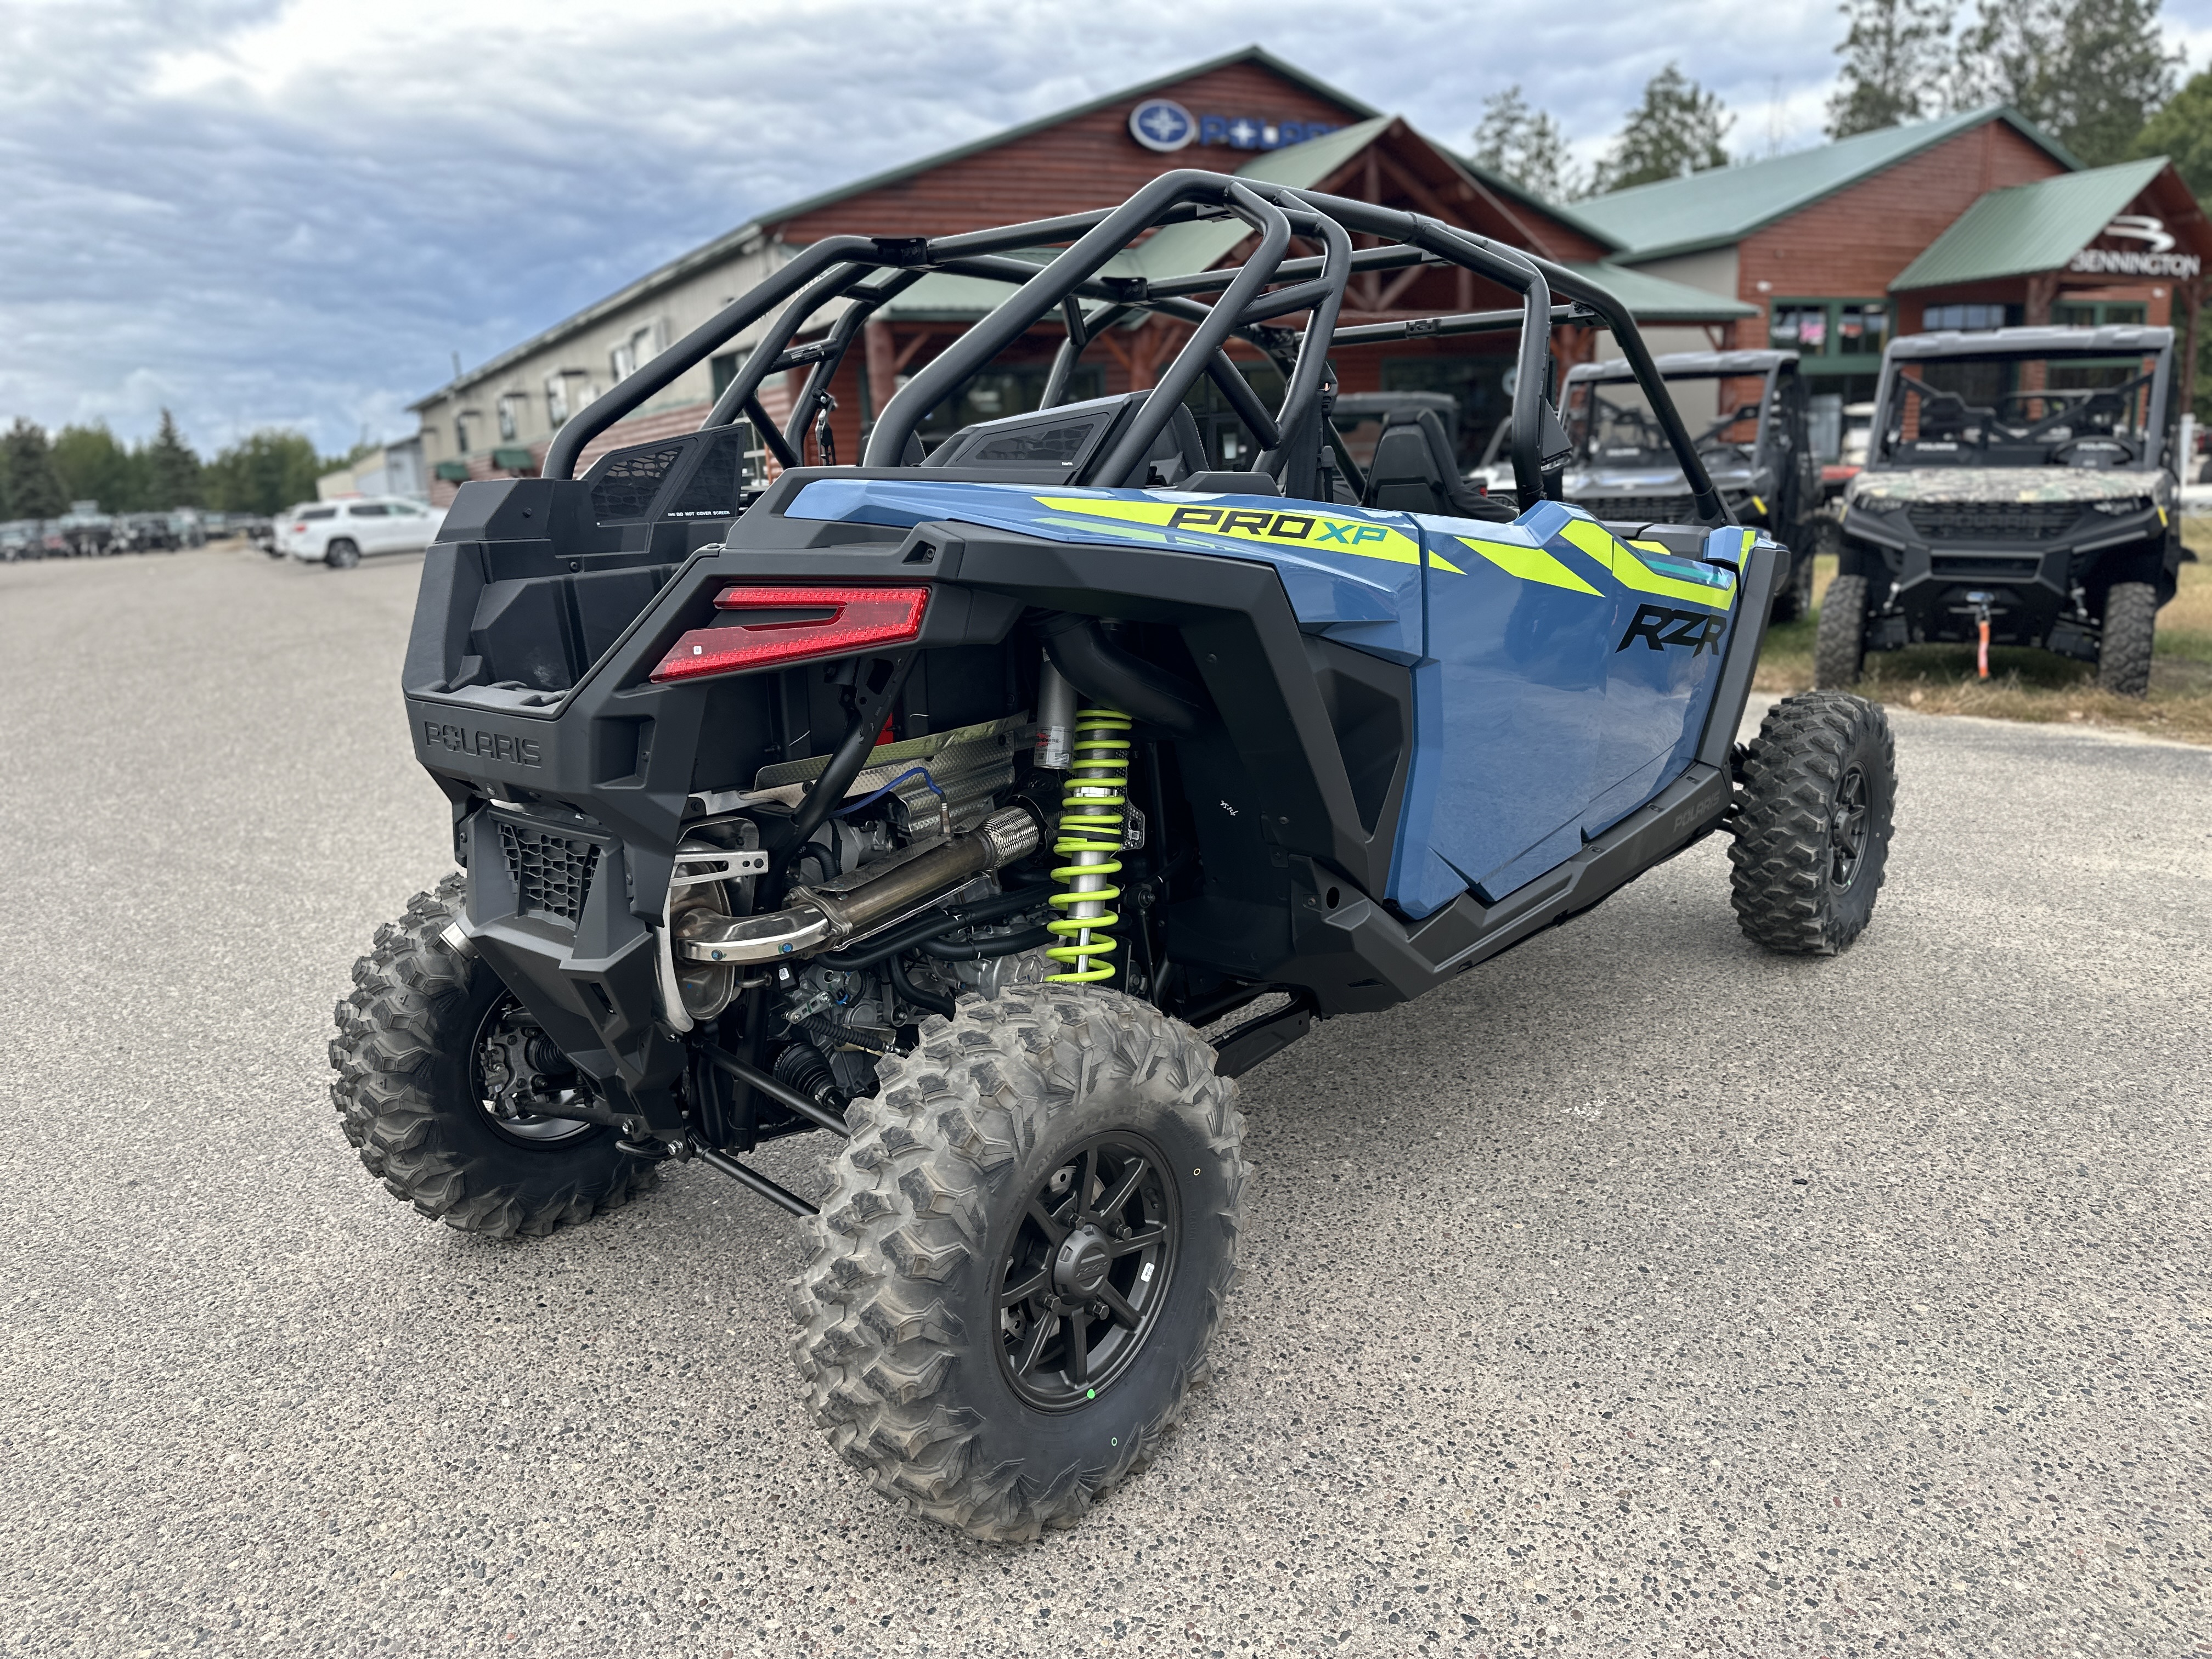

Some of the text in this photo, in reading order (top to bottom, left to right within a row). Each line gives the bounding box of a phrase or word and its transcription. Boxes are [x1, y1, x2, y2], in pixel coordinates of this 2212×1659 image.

[1200, 114, 1339, 150] POLAR
[1166, 507, 1389, 545] PRO XP
[1615, 603, 1728, 658] RZR
[425, 721, 542, 769] POLARIS
[1672, 788, 1722, 834] POLARIS
